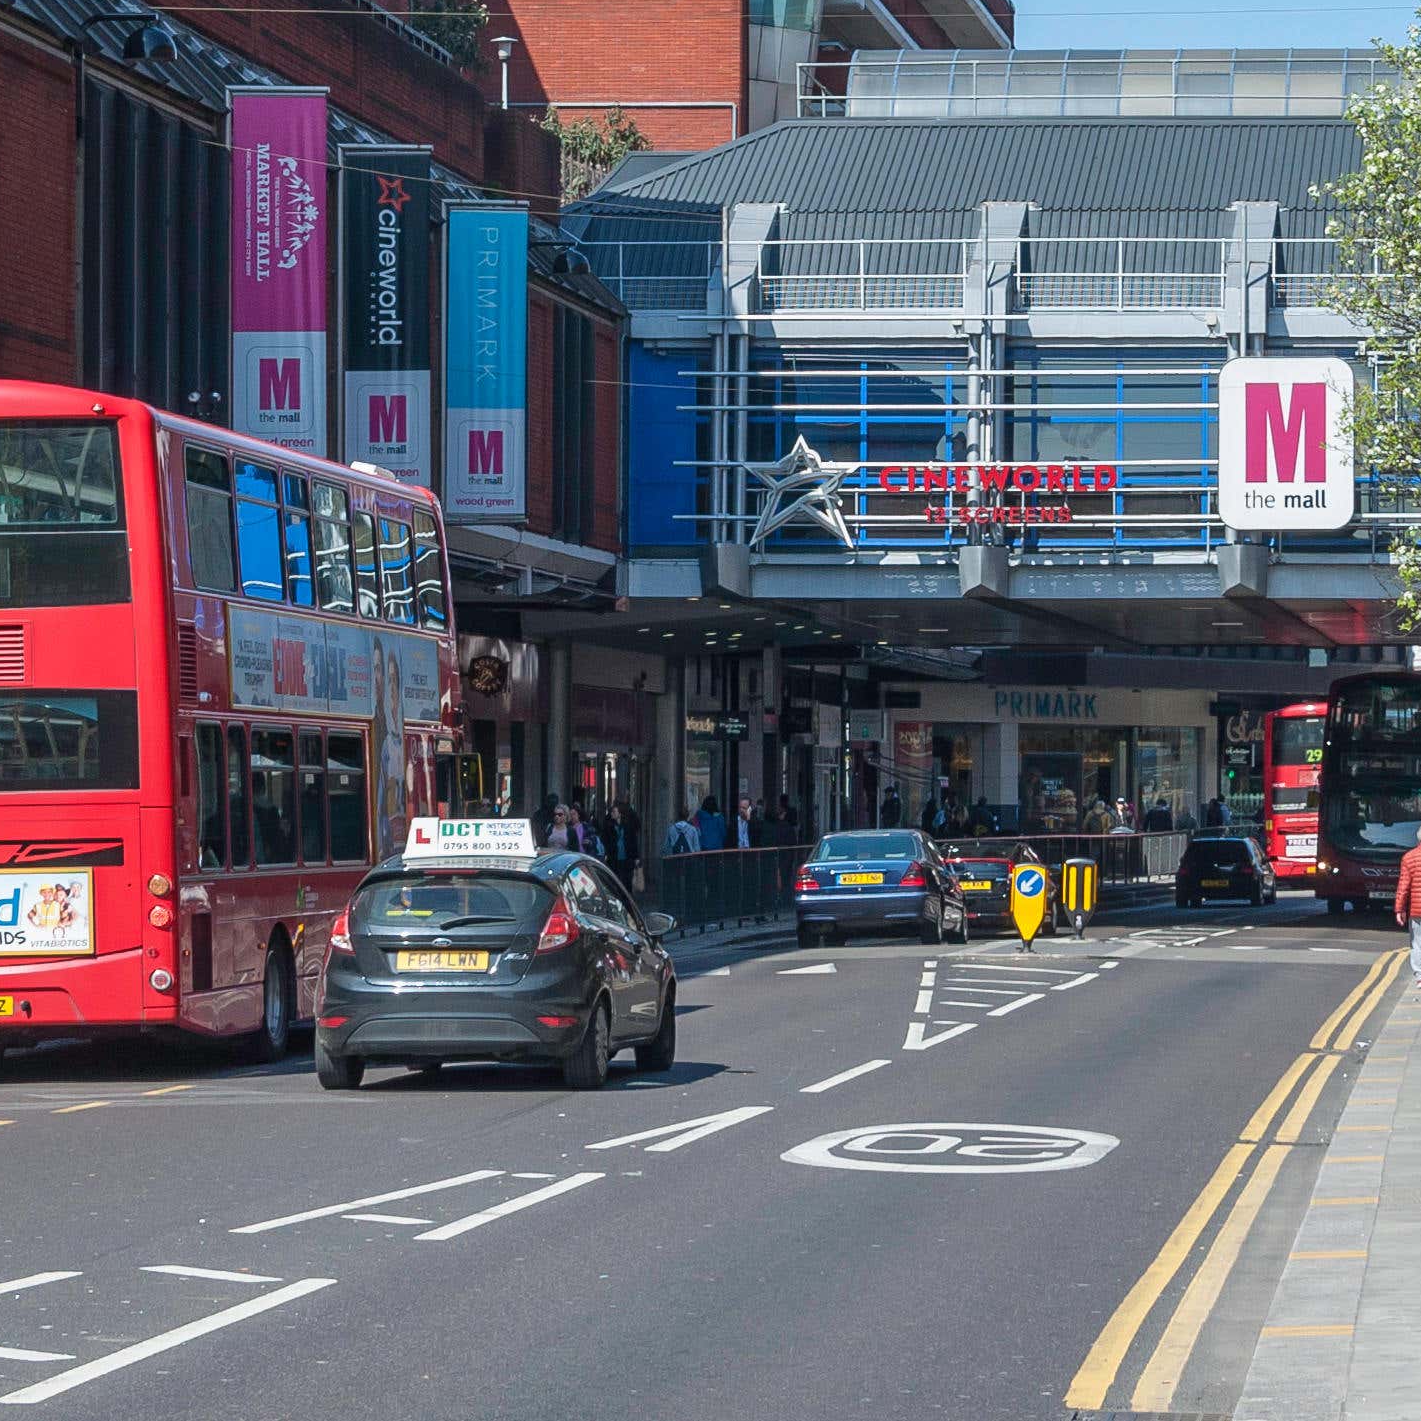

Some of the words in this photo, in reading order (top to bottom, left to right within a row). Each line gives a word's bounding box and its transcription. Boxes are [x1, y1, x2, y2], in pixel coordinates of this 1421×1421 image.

[257, 143, 270, 226] MARKET
[257, 231, 270, 282] HALL
[378, 209, 403, 345] cineworld
[477, 226, 500, 384] PRIMARK
[259, 358, 301, 410] M
[259, 411, 275, 423] the
[278, 411, 300, 423] mall
[369, 395, 407, 443] M
[1245, 383, 1326, 483] M
[369, 444, 384, 455] the
[386, 444, 407, 455] mall
[469, 430, 503, 475] M
[484, 474, 503, 486] mall
[879, 465, 1117, 493] CINEWORLD
[456, 497, 485, 507] wood
[486, 497, 514, 509] green
[1244, 490, 1275, 509] the
[1284, 489, 1327, 509] mall
[925, 507, 946, 524] 12
[959, 507, 1073, 524] SCREENS
[994, 691, 1099, 718] PRIMARK
[1306, 749, 1323, 763] 29
[416, 828, 431, 844] L
[441, 822, 484, 837] DCT
[472, 842, 491, 850] 800
[30, 939, 88, 948] VITABIOTICS
